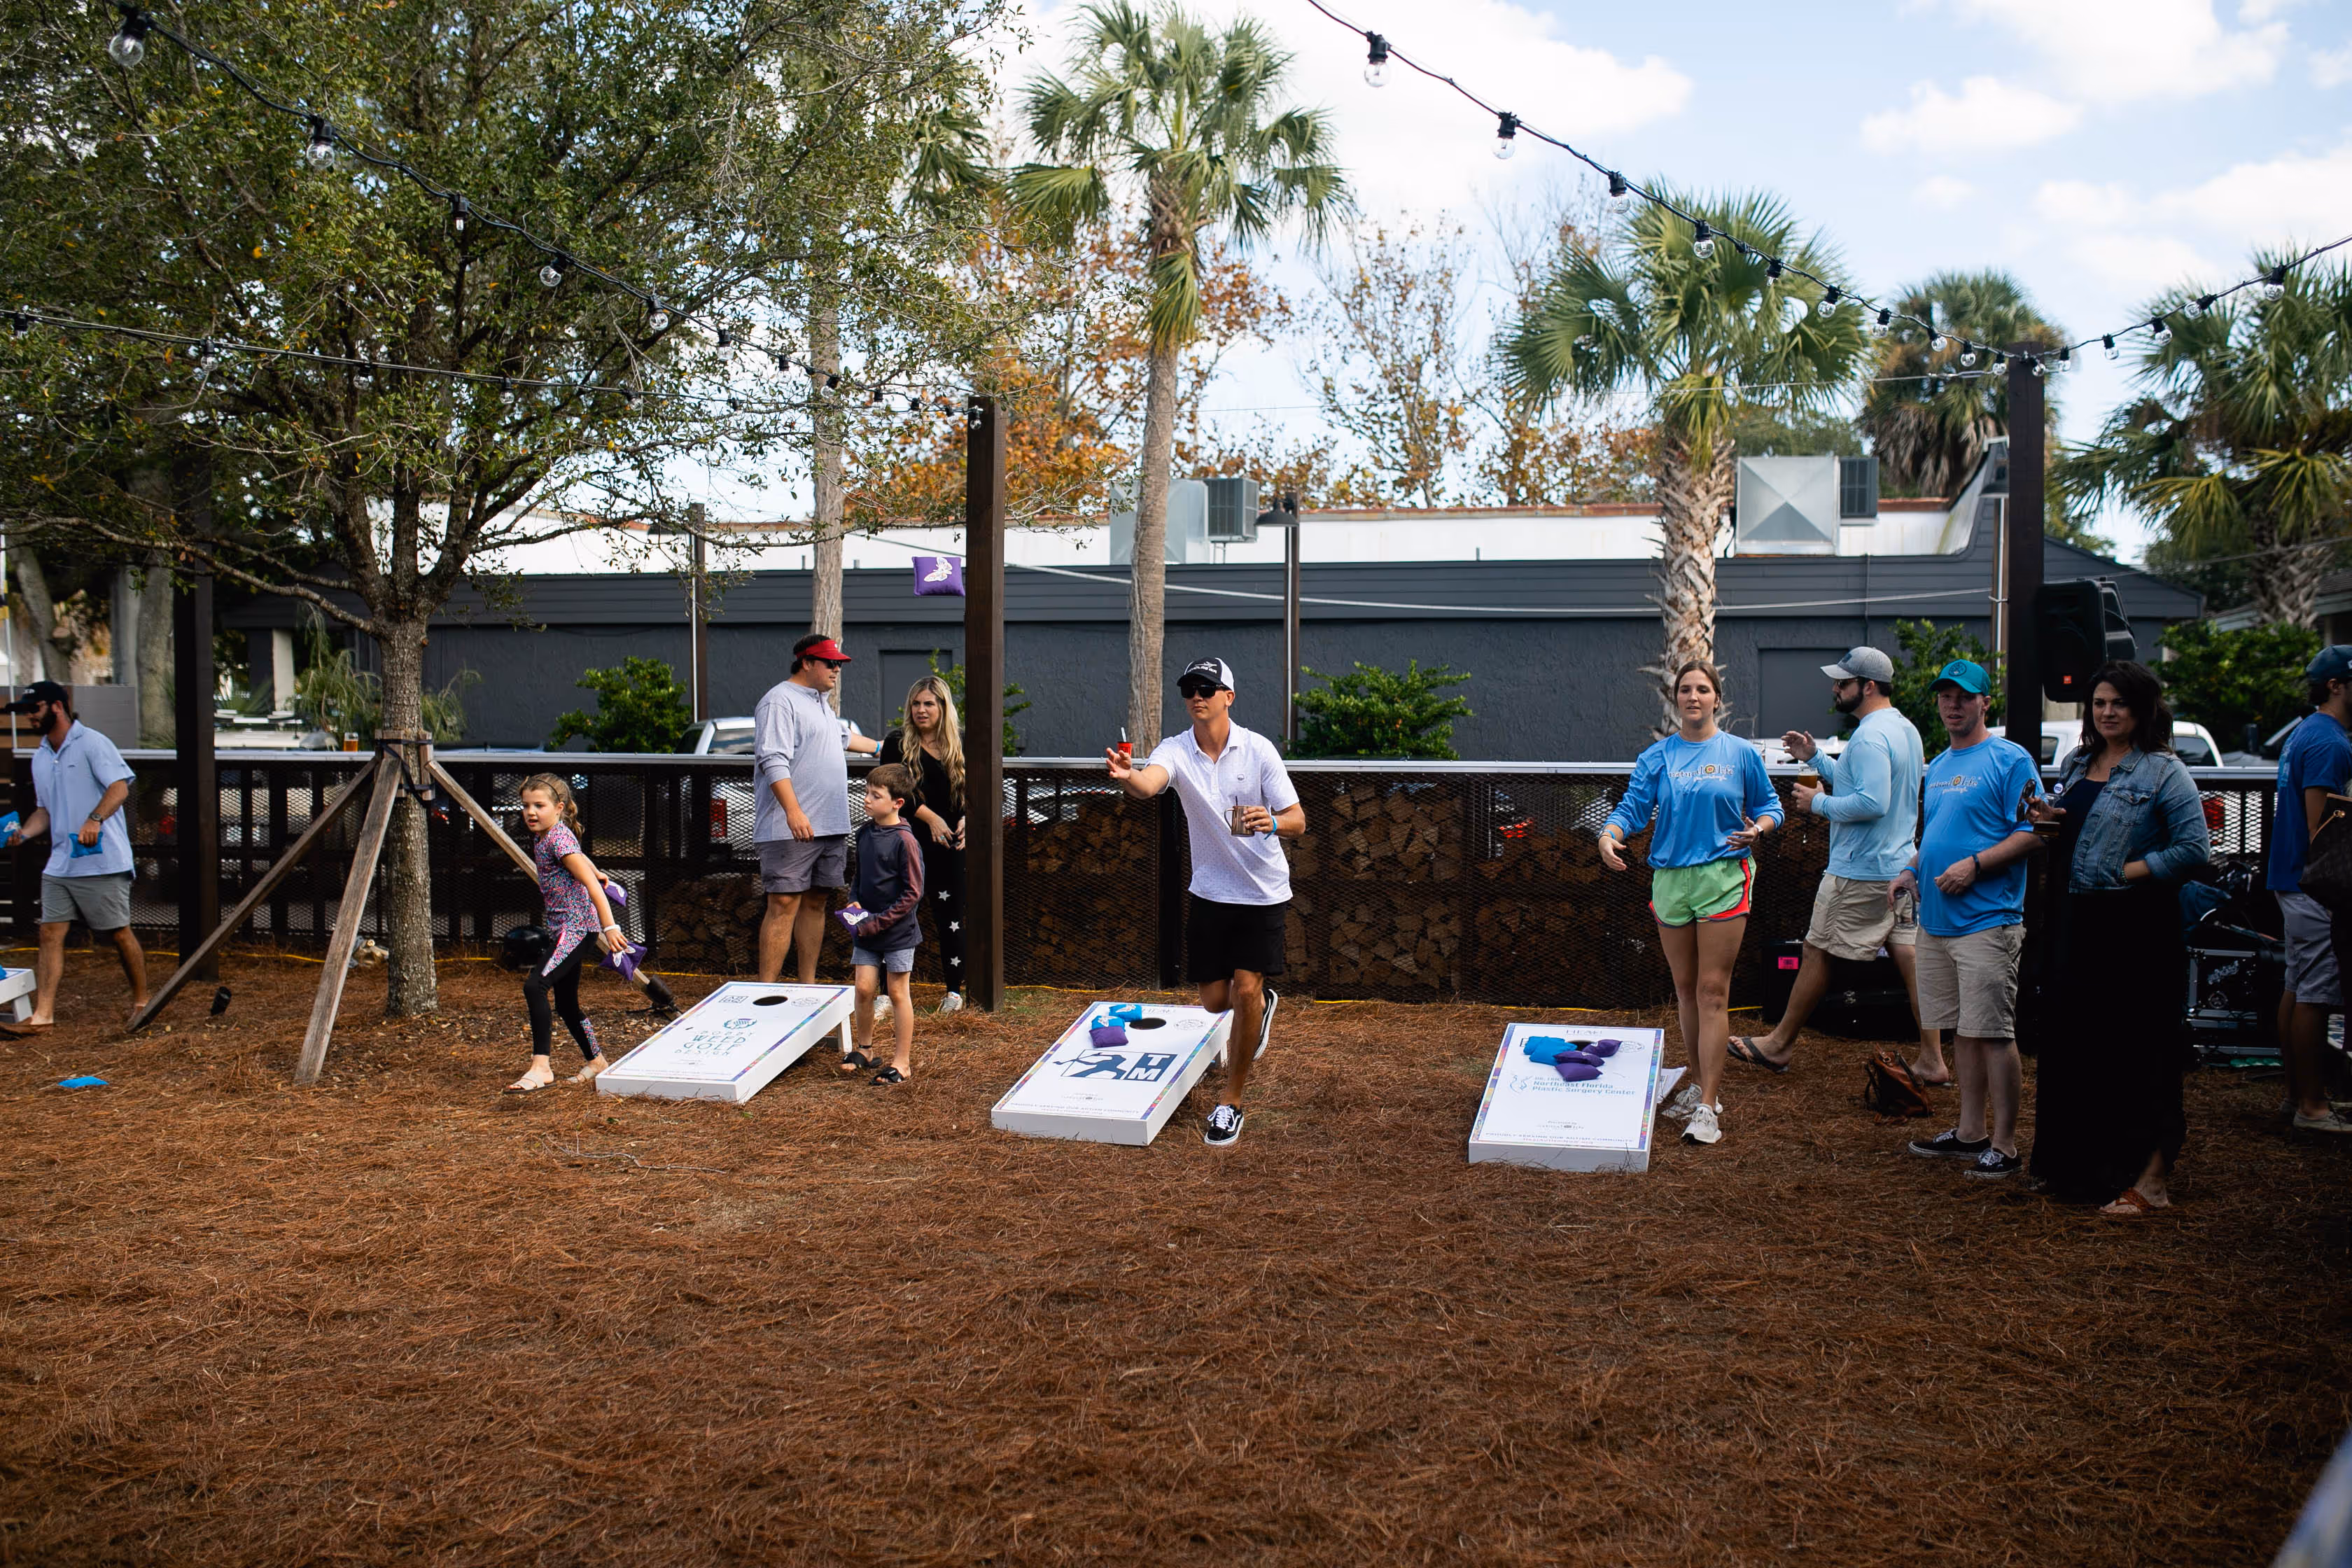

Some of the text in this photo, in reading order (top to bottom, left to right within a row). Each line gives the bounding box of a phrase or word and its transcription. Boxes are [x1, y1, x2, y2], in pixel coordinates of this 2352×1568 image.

[1669, 764, 1733, 778] natural life
[693, 1035, 746, 1043] WEED
[684, 1042, 741, 1051] GOLF
